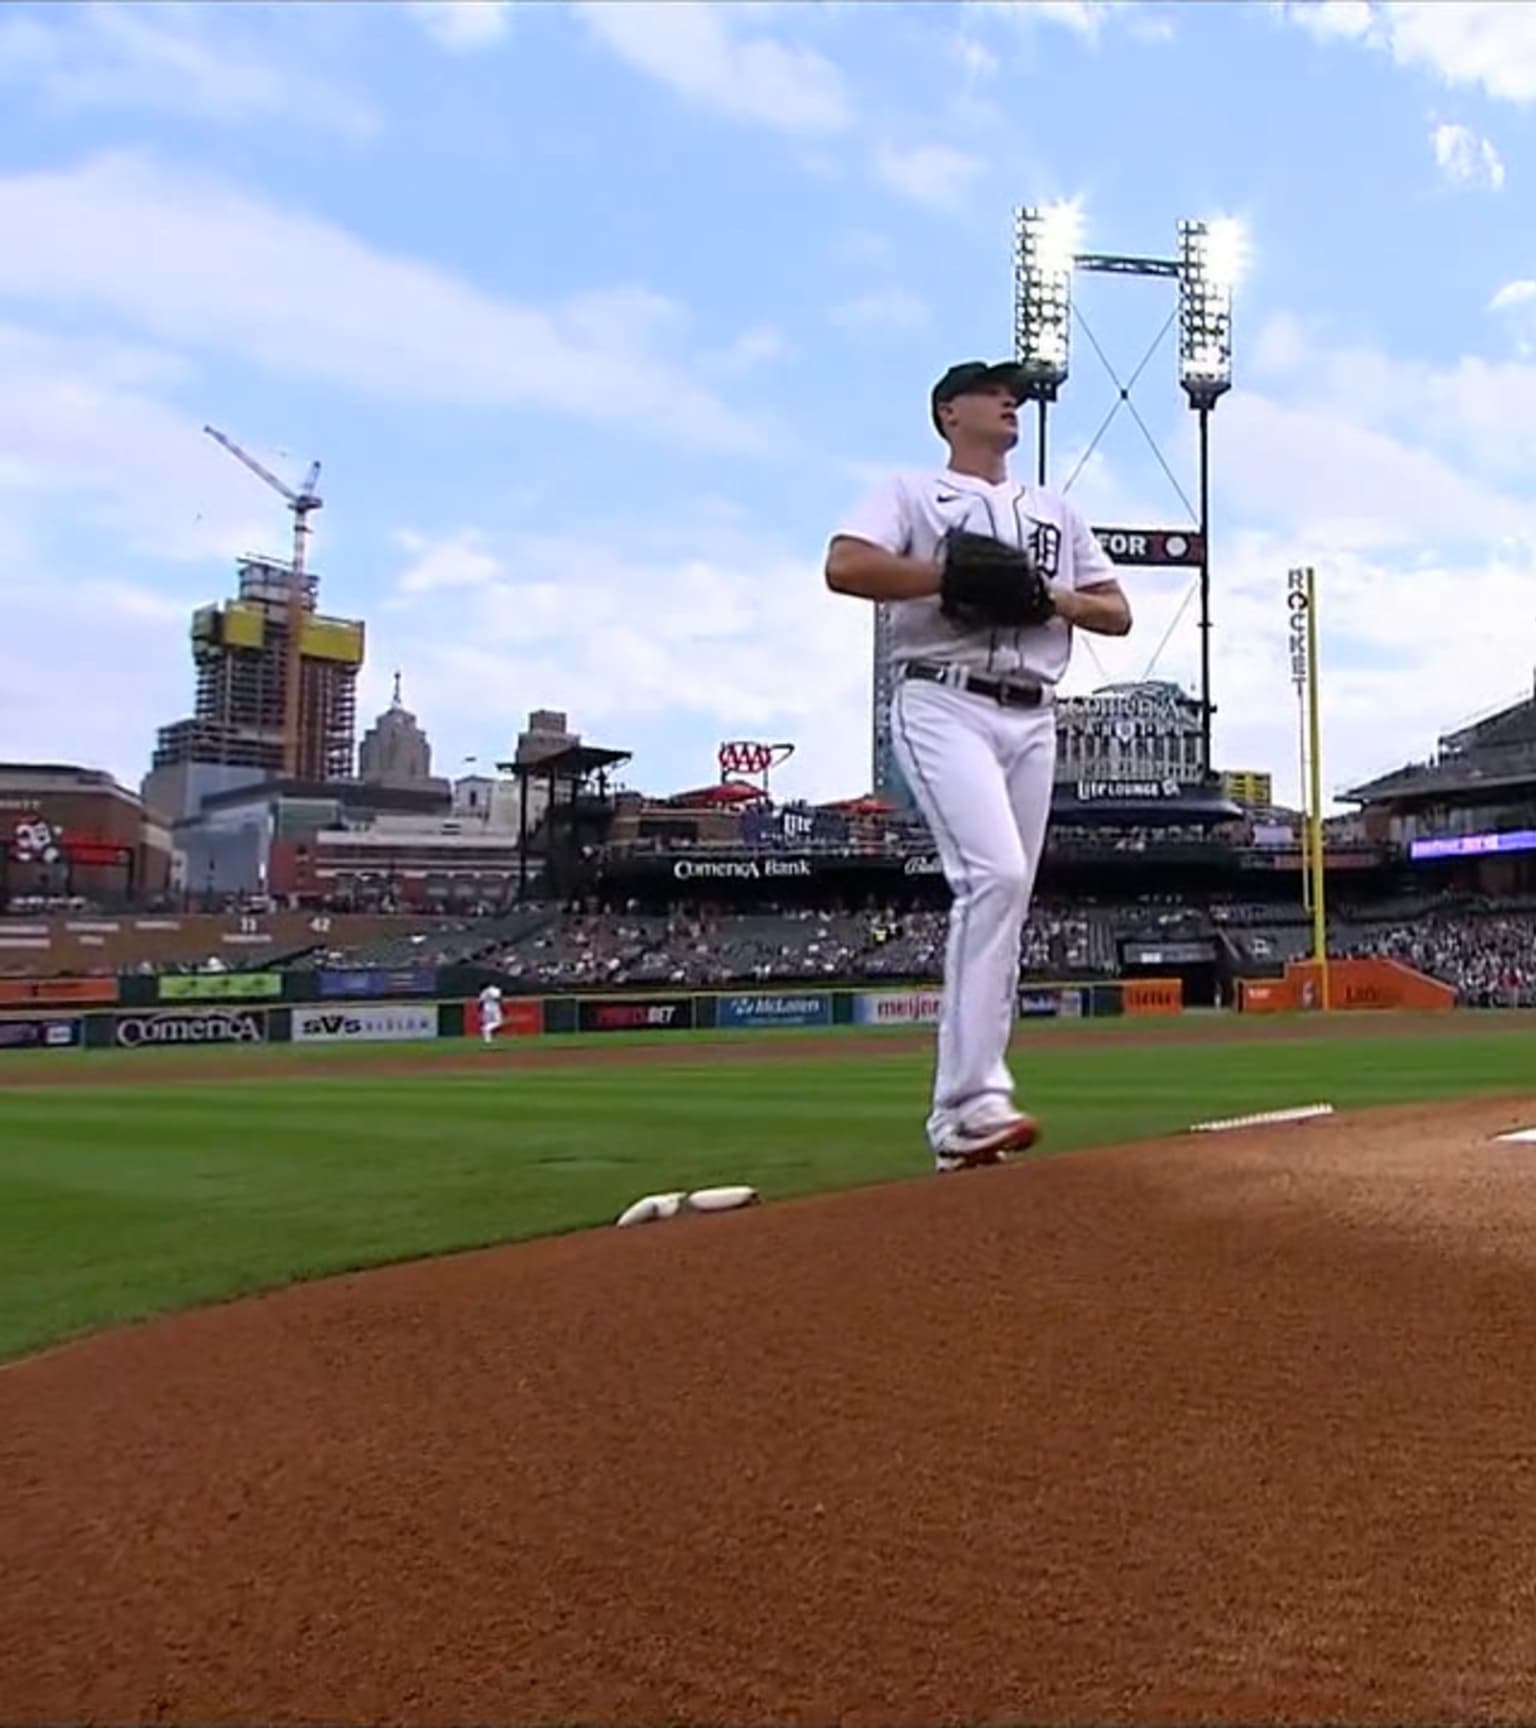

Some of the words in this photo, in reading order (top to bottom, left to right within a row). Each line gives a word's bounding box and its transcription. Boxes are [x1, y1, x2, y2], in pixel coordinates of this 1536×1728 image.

[1102, 533, 1147, 556] FOR
[1287, 568, 1309, 696] ROCKET
[719, 743, 772, 772] AAA
[1108, 783, 1158, 797] LOUNGE
[765, 858, 811, 877] Bank
